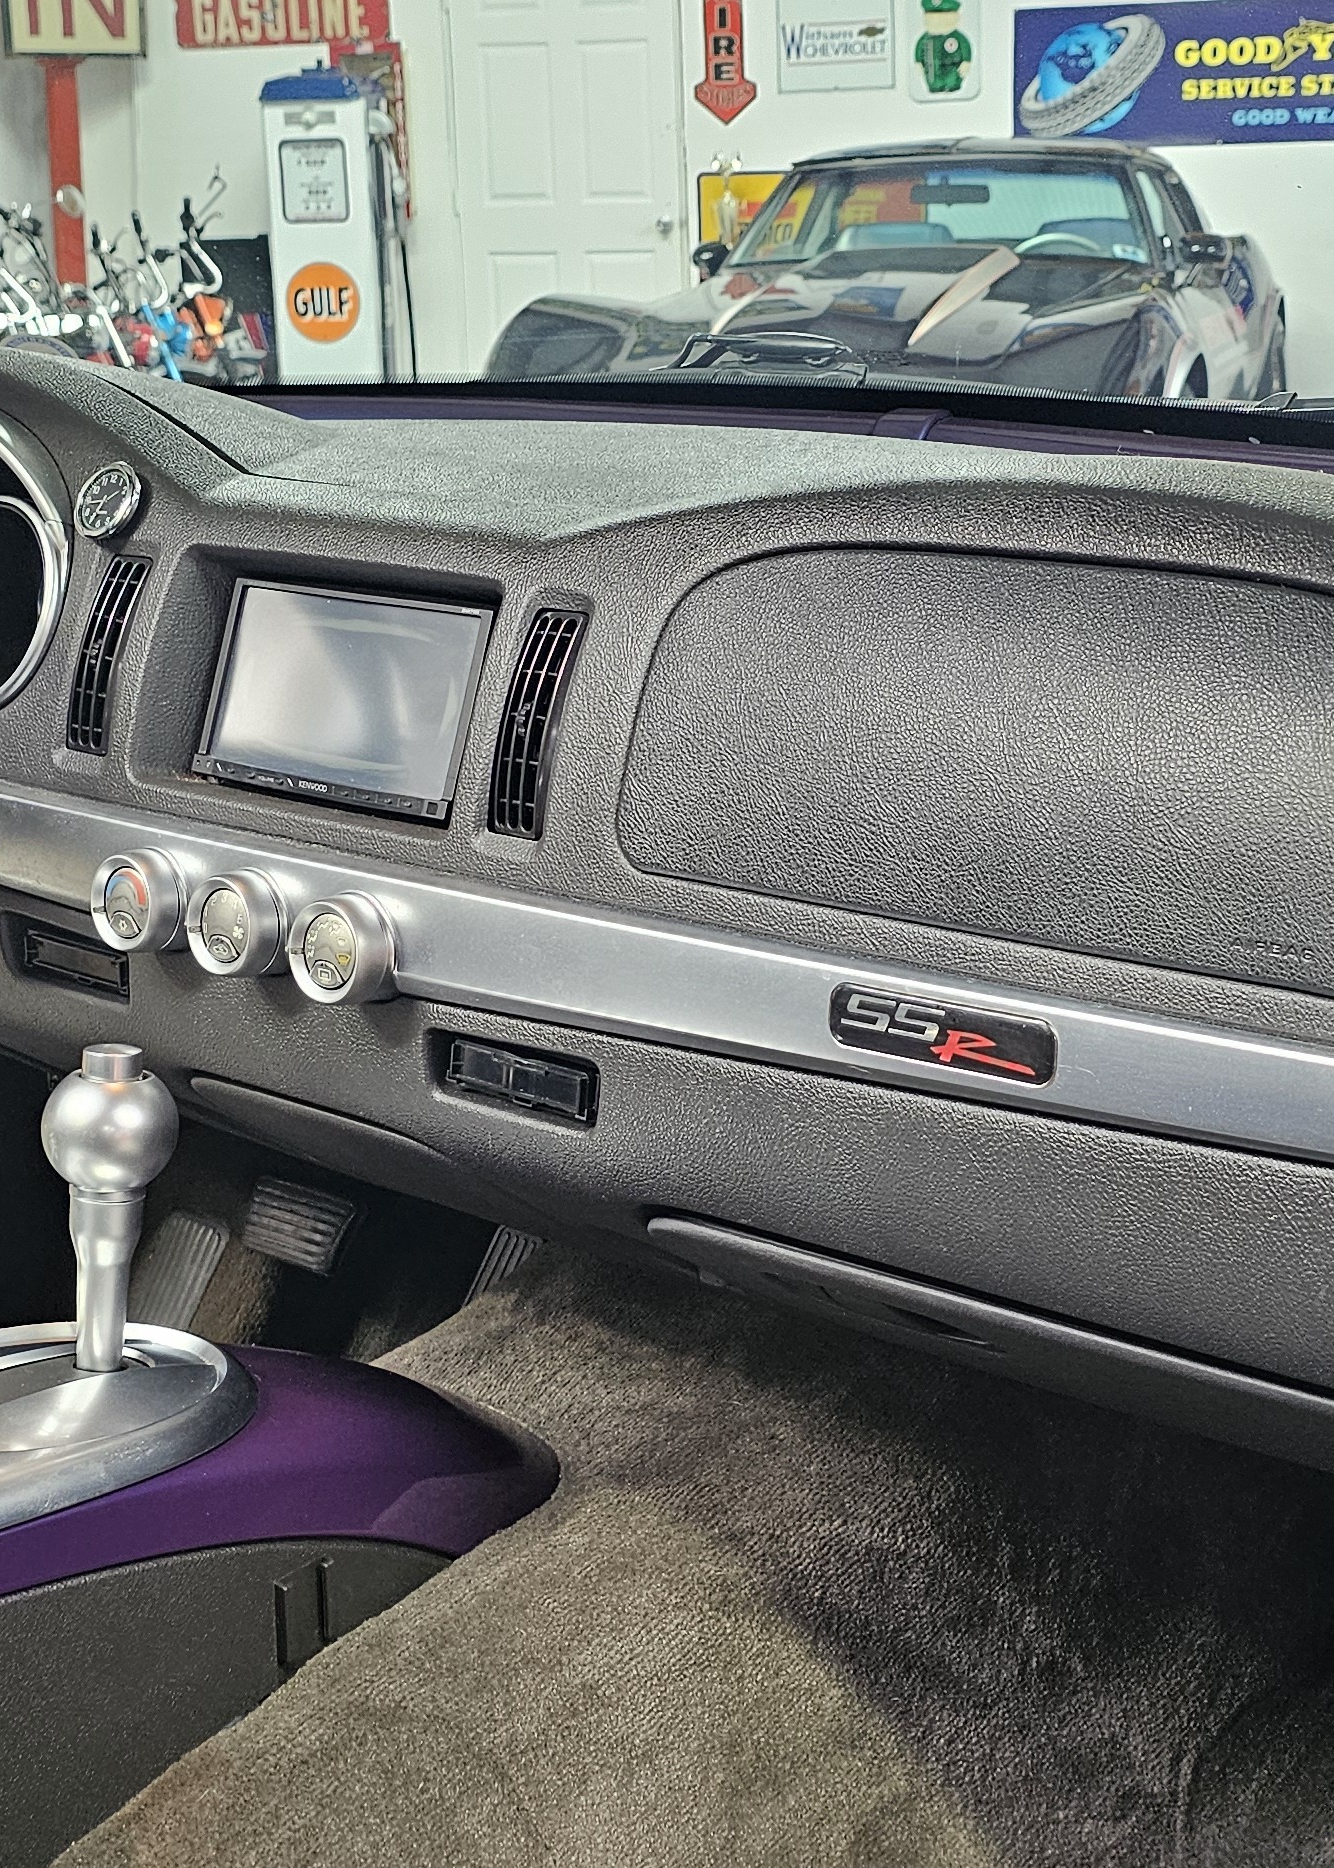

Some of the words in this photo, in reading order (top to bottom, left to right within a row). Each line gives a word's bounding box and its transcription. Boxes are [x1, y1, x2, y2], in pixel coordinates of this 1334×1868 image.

[193, 0, 370, 45] GASOLINE
[1181, 76, 1296, 101] SERVICE
[1231, 108, 1291, 126] GOOD
[294, 286, 352, 320] GULF
[298, 780, 328, 793] KENWOOD
[839, 992, 1037, 1077] SSR
